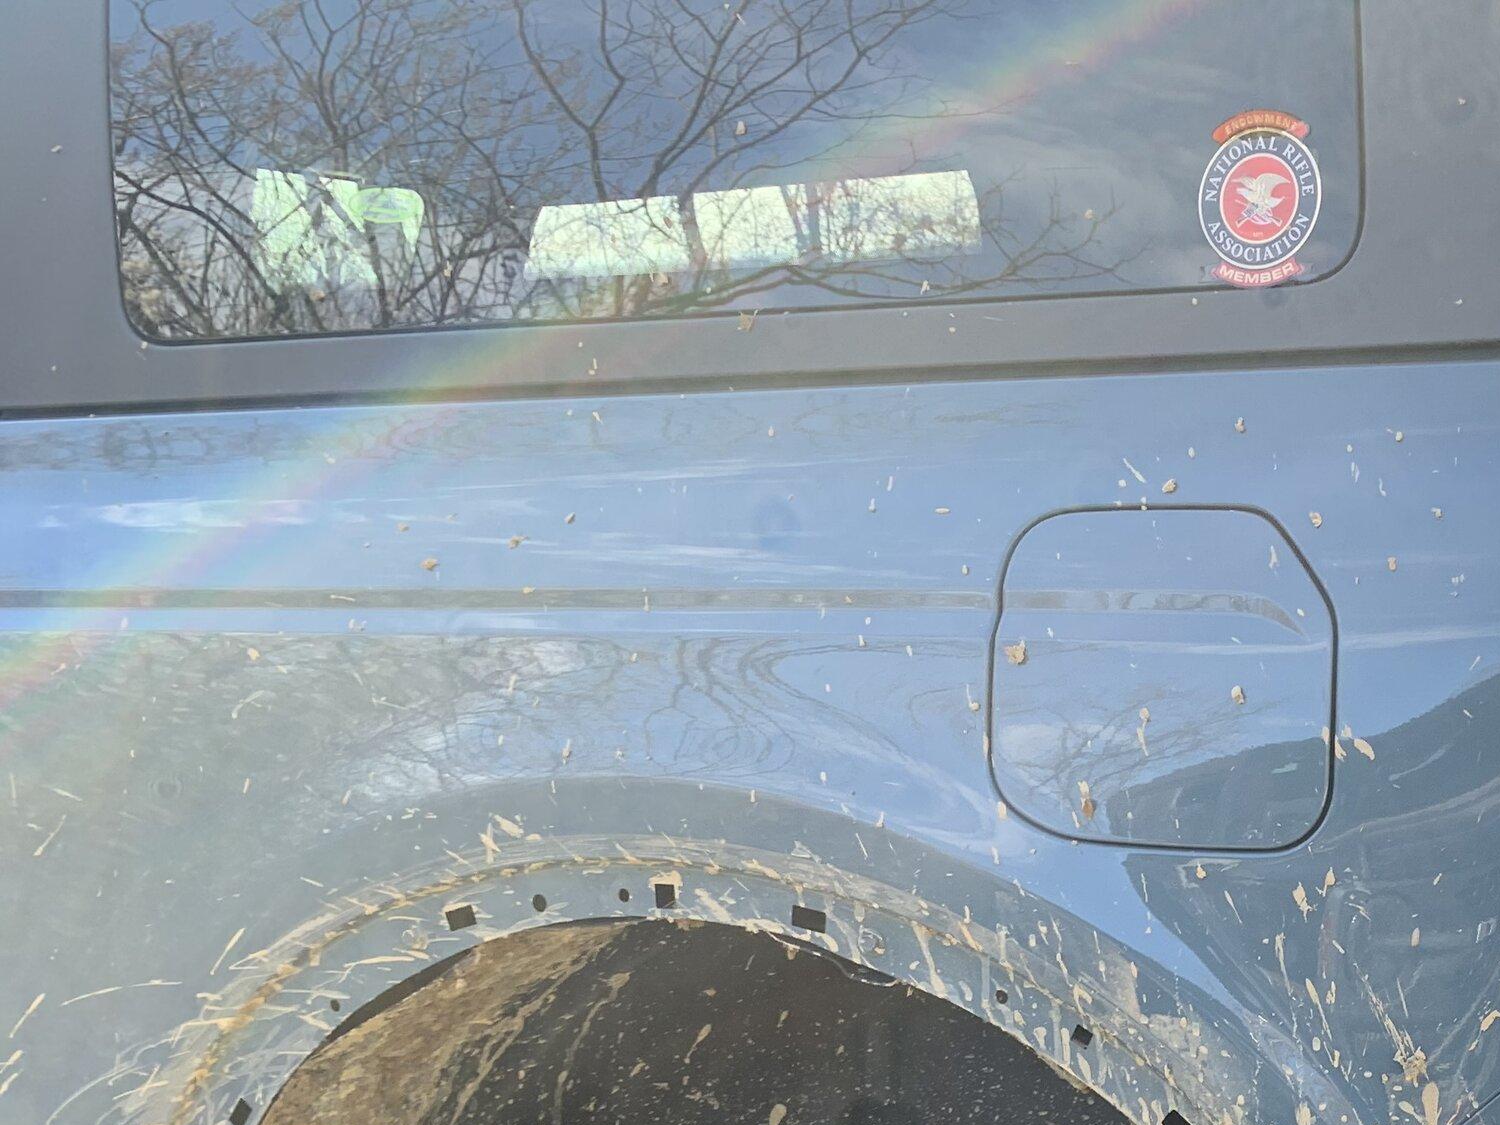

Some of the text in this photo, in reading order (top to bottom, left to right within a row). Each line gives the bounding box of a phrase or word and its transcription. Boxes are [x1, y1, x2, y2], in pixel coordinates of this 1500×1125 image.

[1224, 114, 1298, 135] ENDOWMENT
[1205, 136, 1314, 202] NATIONAL RIFLE
[1208, 213, 1310, 262] ASSOCIATION
[1219, 264, 1296, 284] MEMBER
